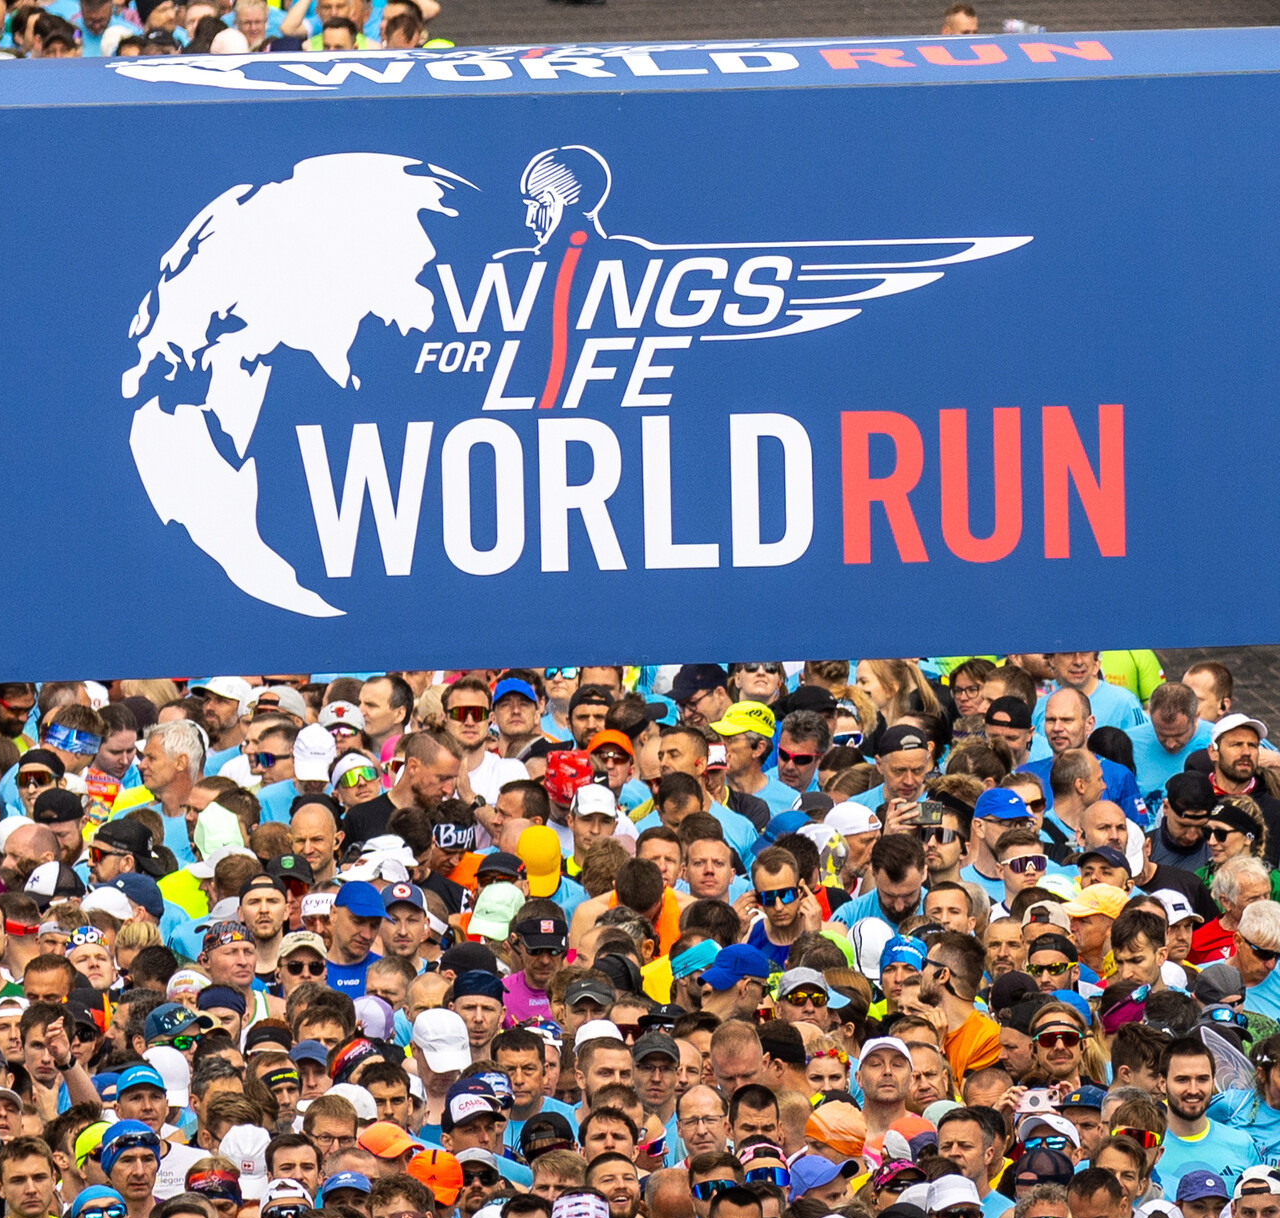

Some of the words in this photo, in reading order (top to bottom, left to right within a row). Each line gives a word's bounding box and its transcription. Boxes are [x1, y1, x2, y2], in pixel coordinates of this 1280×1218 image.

[280, 51, 800, 86] WORLD
[819, 40, 1113, 70] RUN
[414, 339, 491, 375] FOR
[295, 412, 815, 578] WORLD
[839, 403, 1126, 565] RUN
